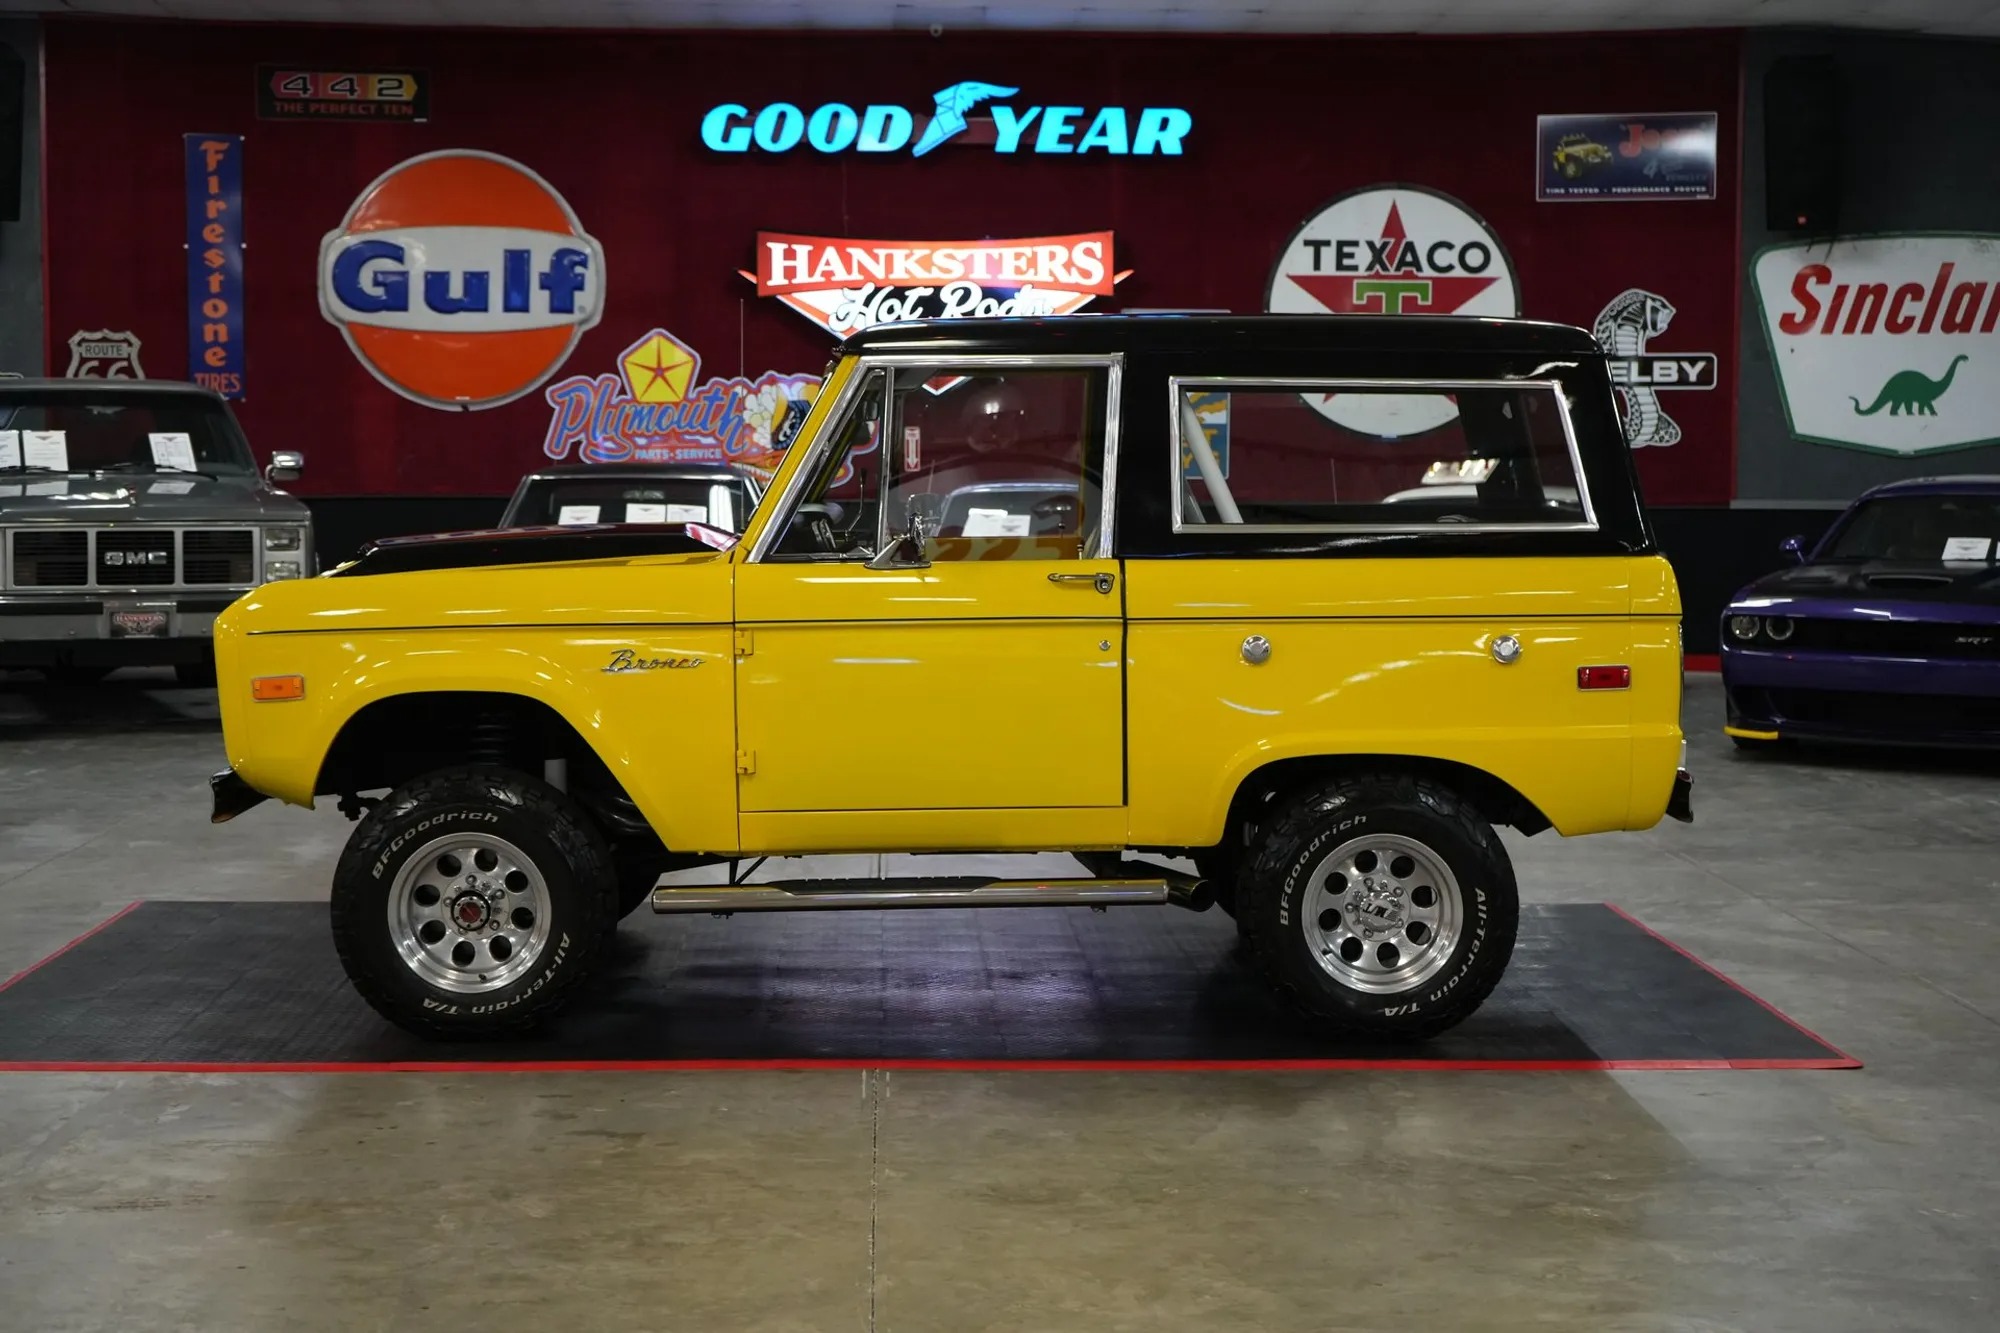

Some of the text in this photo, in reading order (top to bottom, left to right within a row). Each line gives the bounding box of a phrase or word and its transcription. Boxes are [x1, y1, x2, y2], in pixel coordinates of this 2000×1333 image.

[275, 102, 413, 115] THE PERFECT TEN
[701, 102, 1192, 155] GOOD YEAR
[199, 140, 229, 367] Firestone
[766, 240, 1105, 287] HANKSTERS
[1303, 239, 1491, 274] TEXACO
[332, 239, 589, 315] Gulf
[84, 344, 123, 357] ROUTE
[194, 372, 241, 393] TIRES
[555, 382, 748, 461] Plymouth
[634, 448, 722, 460] PARTS SERVICE
[104, 551, 167, 565] GMC
[601, 648, 706, 672] Bronco
[371, 810, 500, 880] BFGoodrich
[1280, 814, 1367, 926] BFGoodrich
[1430, 887, 1488, 1002] All-Terrain
[471, 931, 571, 1015] All-Terrain
[422, 997, 459, 1015] T/A
[1383, 1001, 1421, 1017] T/A
